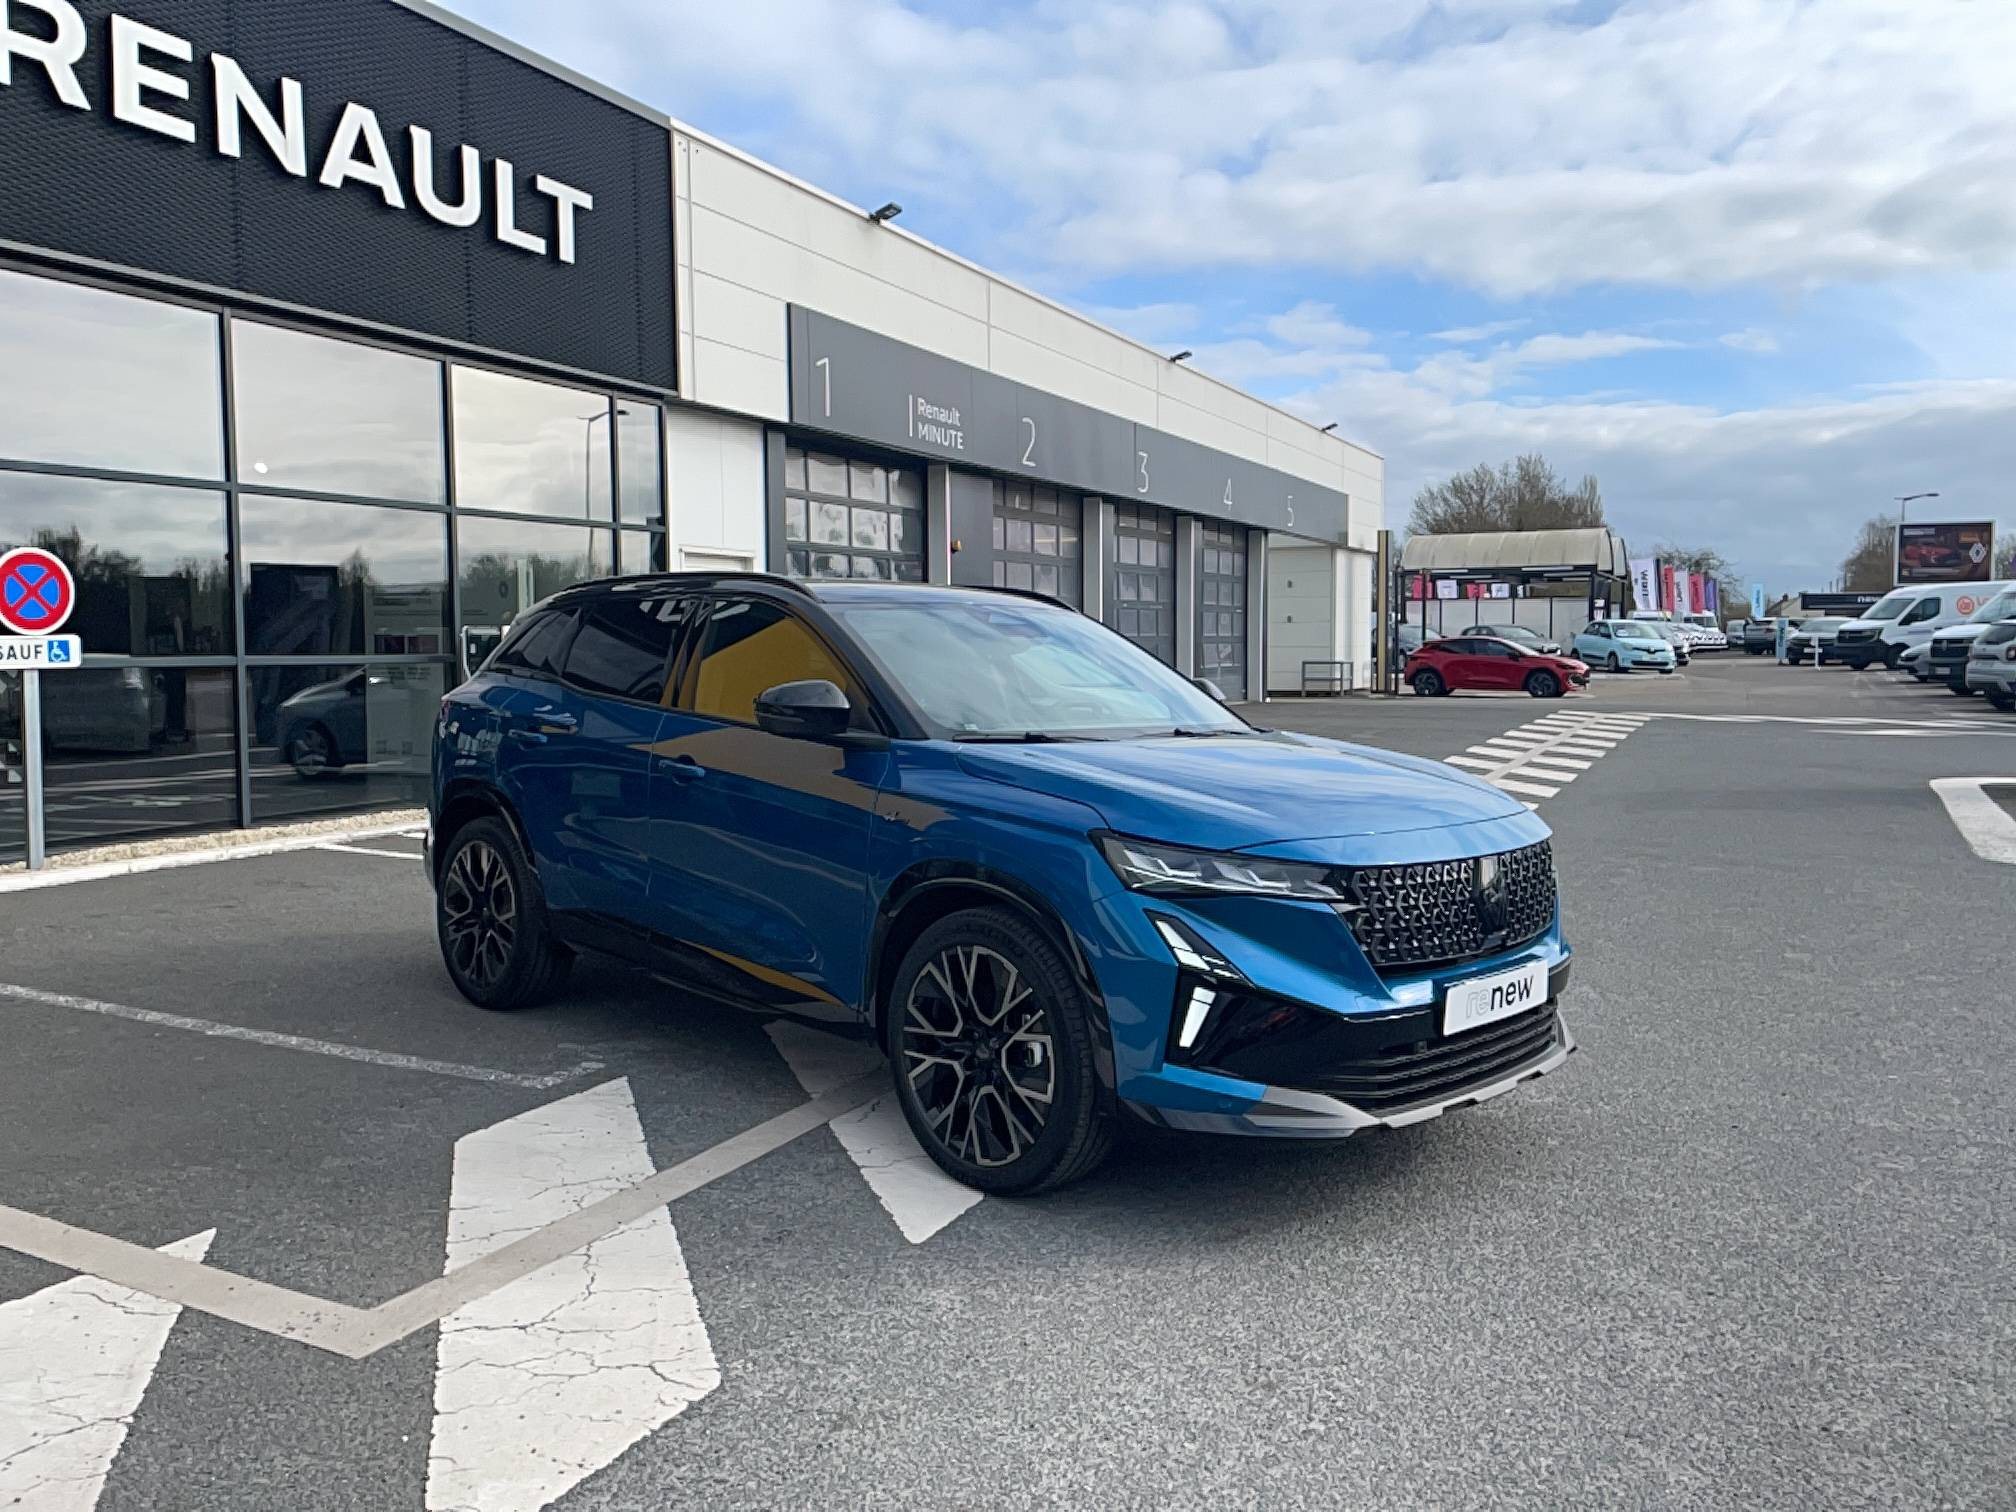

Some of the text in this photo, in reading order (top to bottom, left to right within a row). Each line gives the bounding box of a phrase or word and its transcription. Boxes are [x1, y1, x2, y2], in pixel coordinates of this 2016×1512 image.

[0, 0, 593, 264] RENAULT
[815, 357, 832, 417] 1
[917, 397, 961, 427] Renault
[917, 422, 964, 450] MINUTE
[1021, 416, 1036, 468] 2
[1137, 451, 1149, 493] 3
[1223, 478, 1233, 512] 4
[1287, 495, 1295, 527] 5
